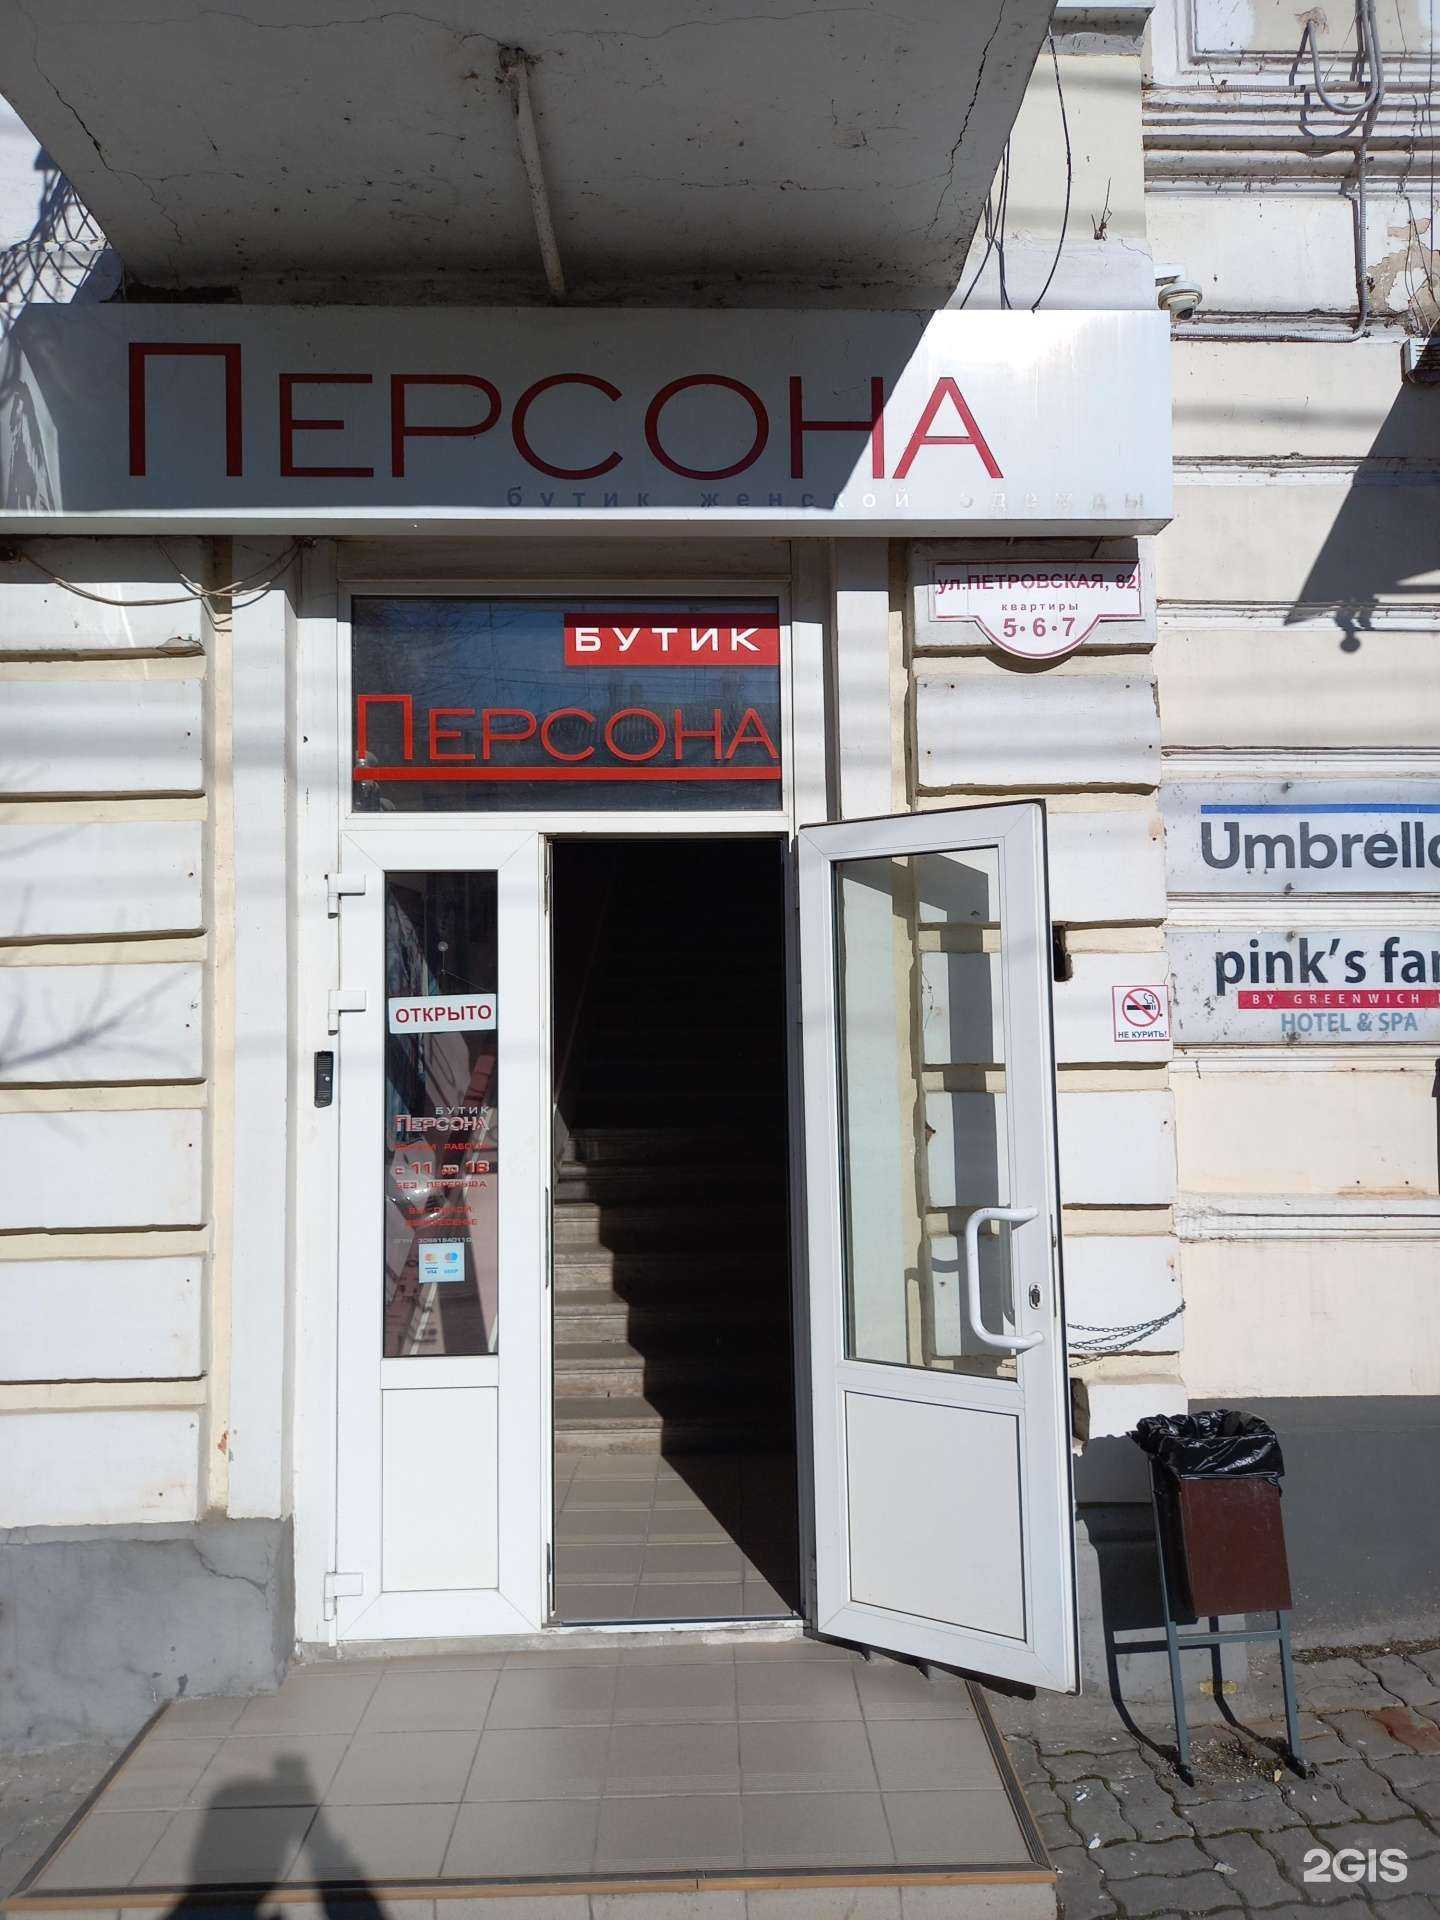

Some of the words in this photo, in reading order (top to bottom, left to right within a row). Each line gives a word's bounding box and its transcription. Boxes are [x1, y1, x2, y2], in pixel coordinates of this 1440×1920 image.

[128, 342, 1004, 480] ПЕРСОНА
[506, 486, 651, 508] бутик
[699, 487, 911, 509] женской
[1115, 574, 1137, 589] 82
[1001, 602, 1079, 614] квартиры
[574, 626, 761, 652] БУТИК
[357, 694, 780, 761] ПЕРСОНА
[1252, 994, 1275, 1005] BY
[1293, 993, 1420, 1005] GREENWICH
[395, 1004, 492, 1024] ОТКРЫТО
[1280, 1013, 1352, 1033] HOTEL
[1356, 1013, 1373, 1032] &
[1378, 1012, 1419, 1032] SPA
[1117, 1031, 1131, 1039] НЕ
[1131, 1030, 1168, 1039] КУРИТЬ!
[435, 1106, 490, 1115] БУТИК
[394, 1114, 490, 1132] ПЕРСОНА
[410, 1161, 433, 1175] 11
